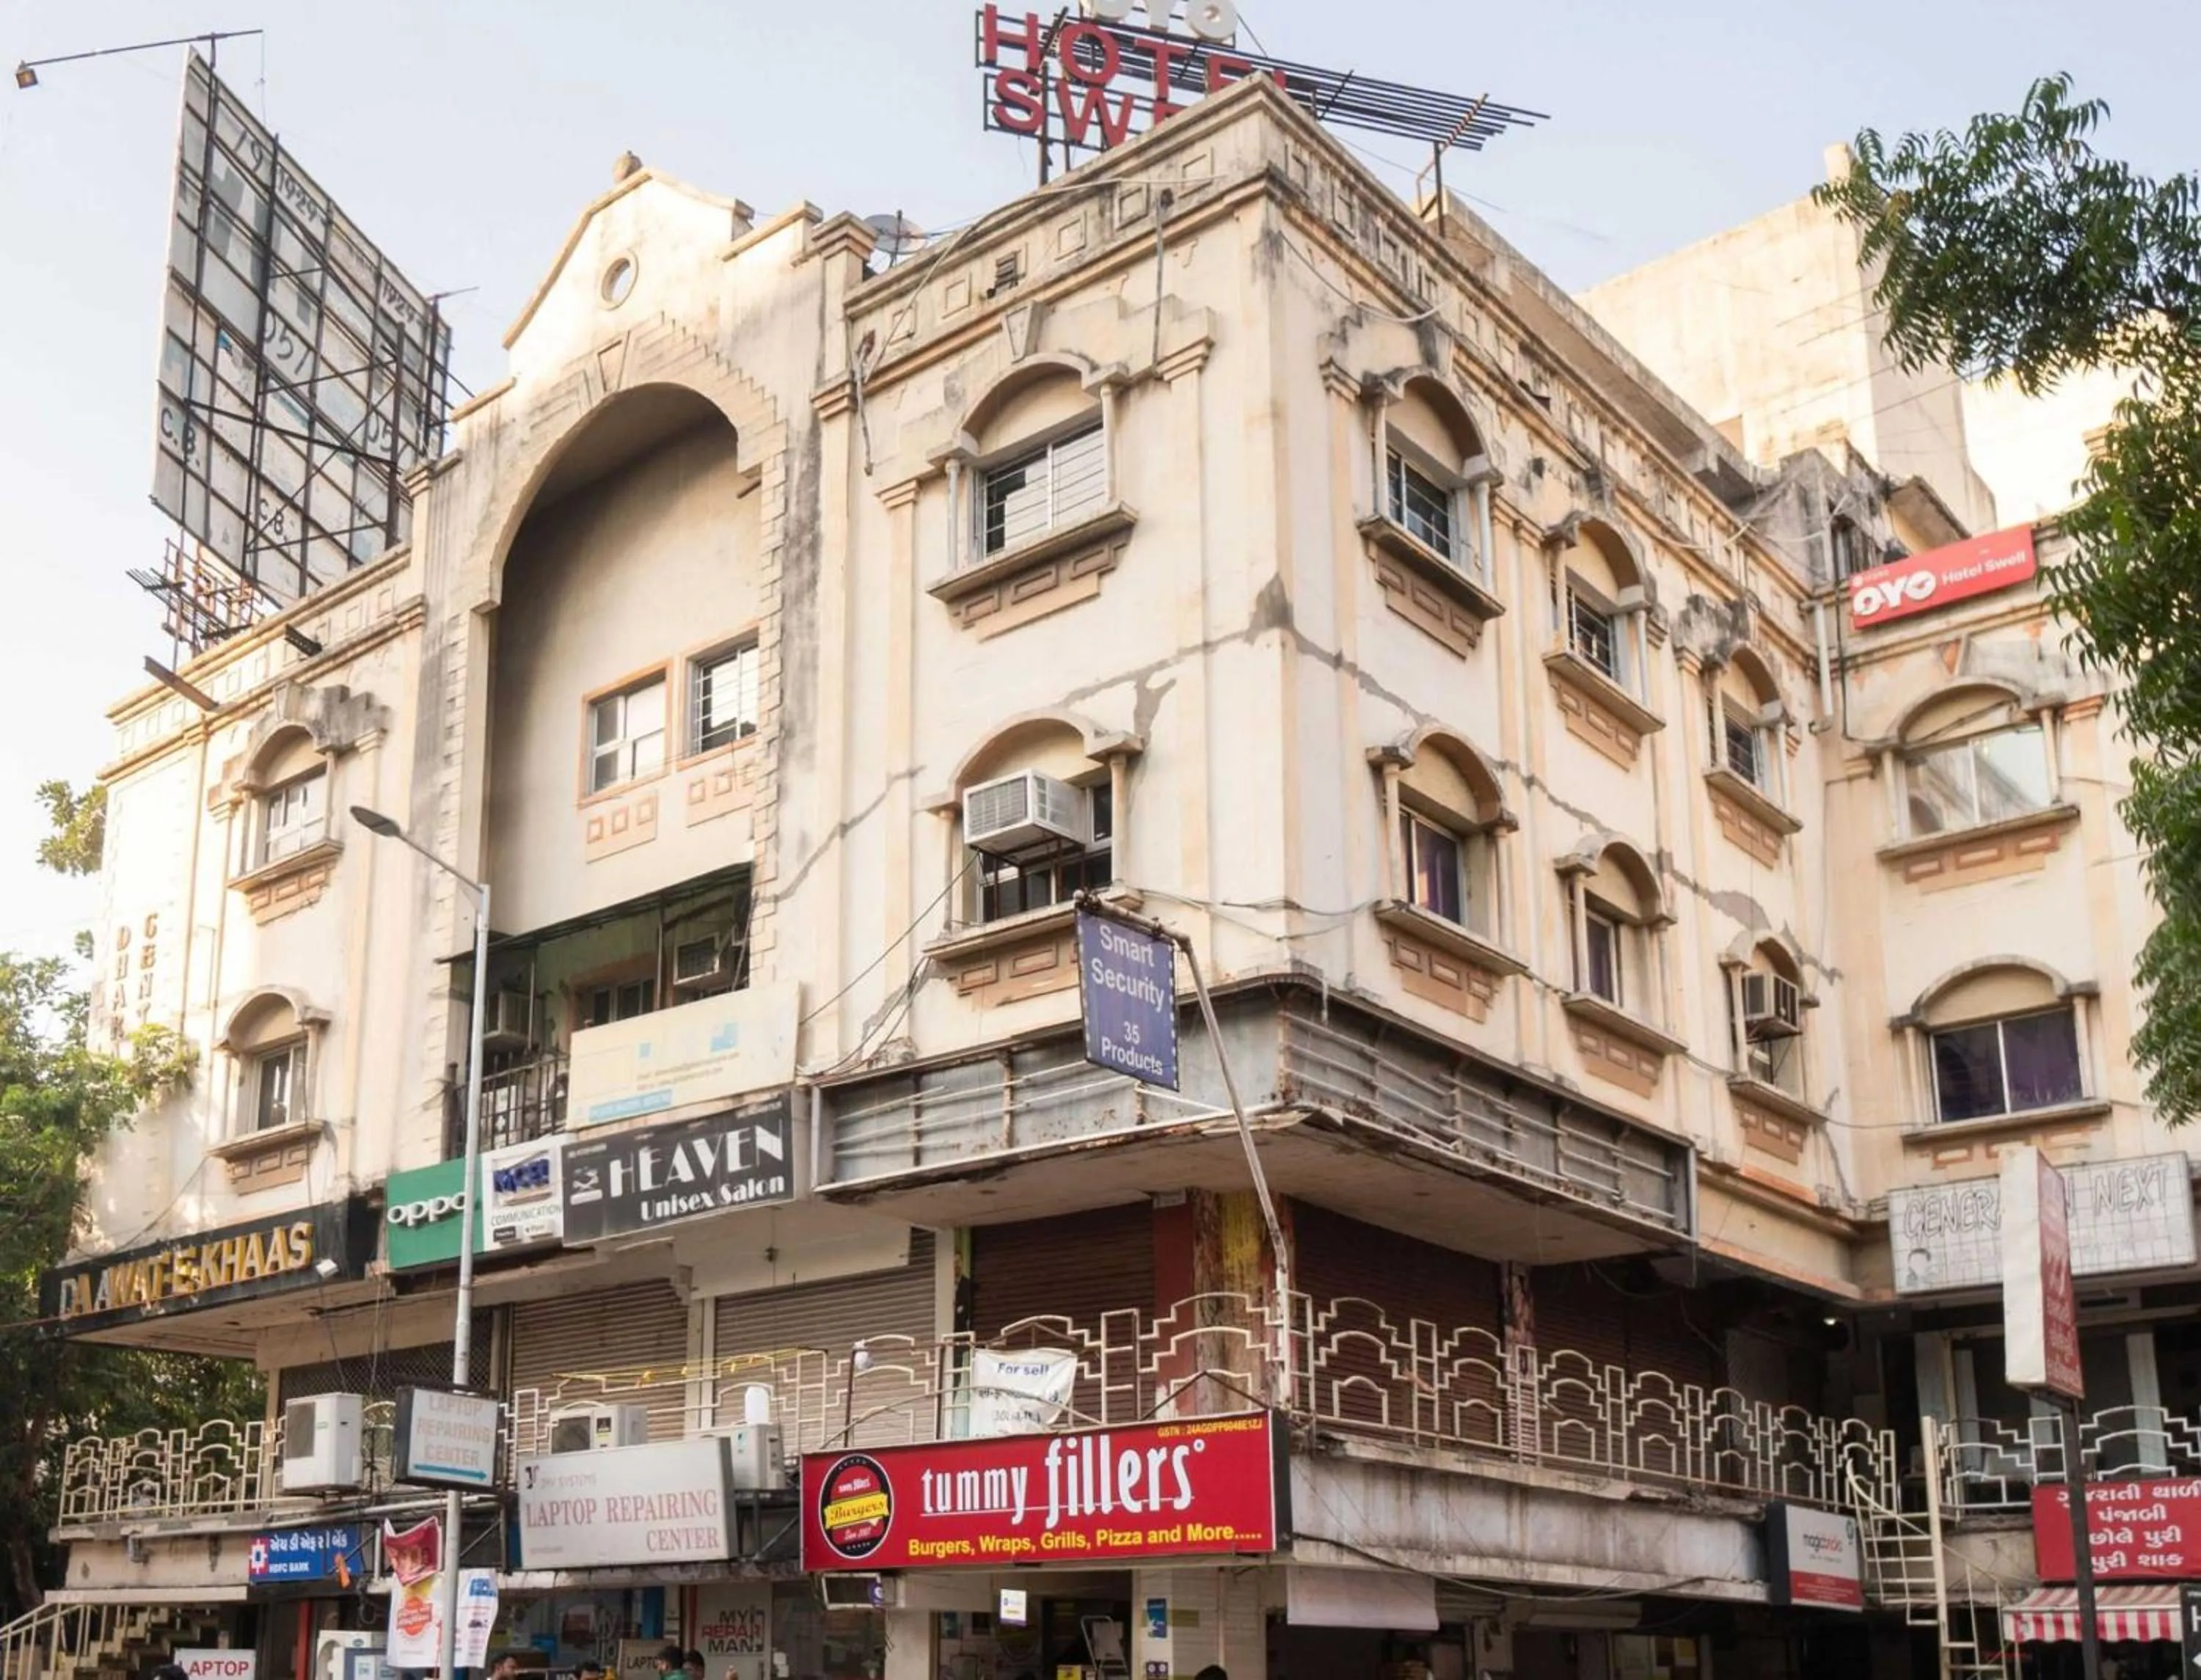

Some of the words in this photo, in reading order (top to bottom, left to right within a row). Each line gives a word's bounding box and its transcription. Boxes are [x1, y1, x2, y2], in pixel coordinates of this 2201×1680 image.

[1941, 563, 1982, 585] Hotel
[1984, 549, 2026, 573] Swell
[1100, 924, 1154, 968] Smart
[1091, 957, 1165, 1013] Security
[1123, 1020, 1139, 1045] 35
[1101, 1036, 1163, 1075] Products
[610, 1118, 784, 1198] HEAVEN
[640, 1192, 715, 1221] Unisex
[720, 1175, 785, 1205] Salon
[2094, 1166, 2167, 1215] NEXT
[998, 1362, 1020, 1374] For
[1024, 1364, 1050, 1376] sell
[428, 1395, 483, 1417] LAPTOP
[416, 1417, 491, 1444] REPAIRING
[424, 1445, 480, 1467] CENTER
[921, 1467, 1028, 1525] tummy
[1044, 1434, 1191, 1530] fillers
[525, 1498, 597, 1527] LAPTOP
[606, 1489, 718, 1524] REPAIRING
[2096, 1502, 2167, 1523] પંજાબી
[646, 1527, 719, 1552] CENTER
[908, 1538, 975, 1559] Burgers,
[979, 1534, 1036, 1555] Wraps,
[1040, 1530, 1092, 1550] Grills,
[1096, 1528, 1142, 1547] Pizza
[1147, 1525, 1181, 1544] and
[2143, 1525, 2182, 1549] પુરી
[269, 1563, 288, 1574] HDFC
[288, 1561, 309, 1572] BANK
[2090, 1550, 2127, 1574] પુરી
[179, 1659, 249, 1676] APTOP
